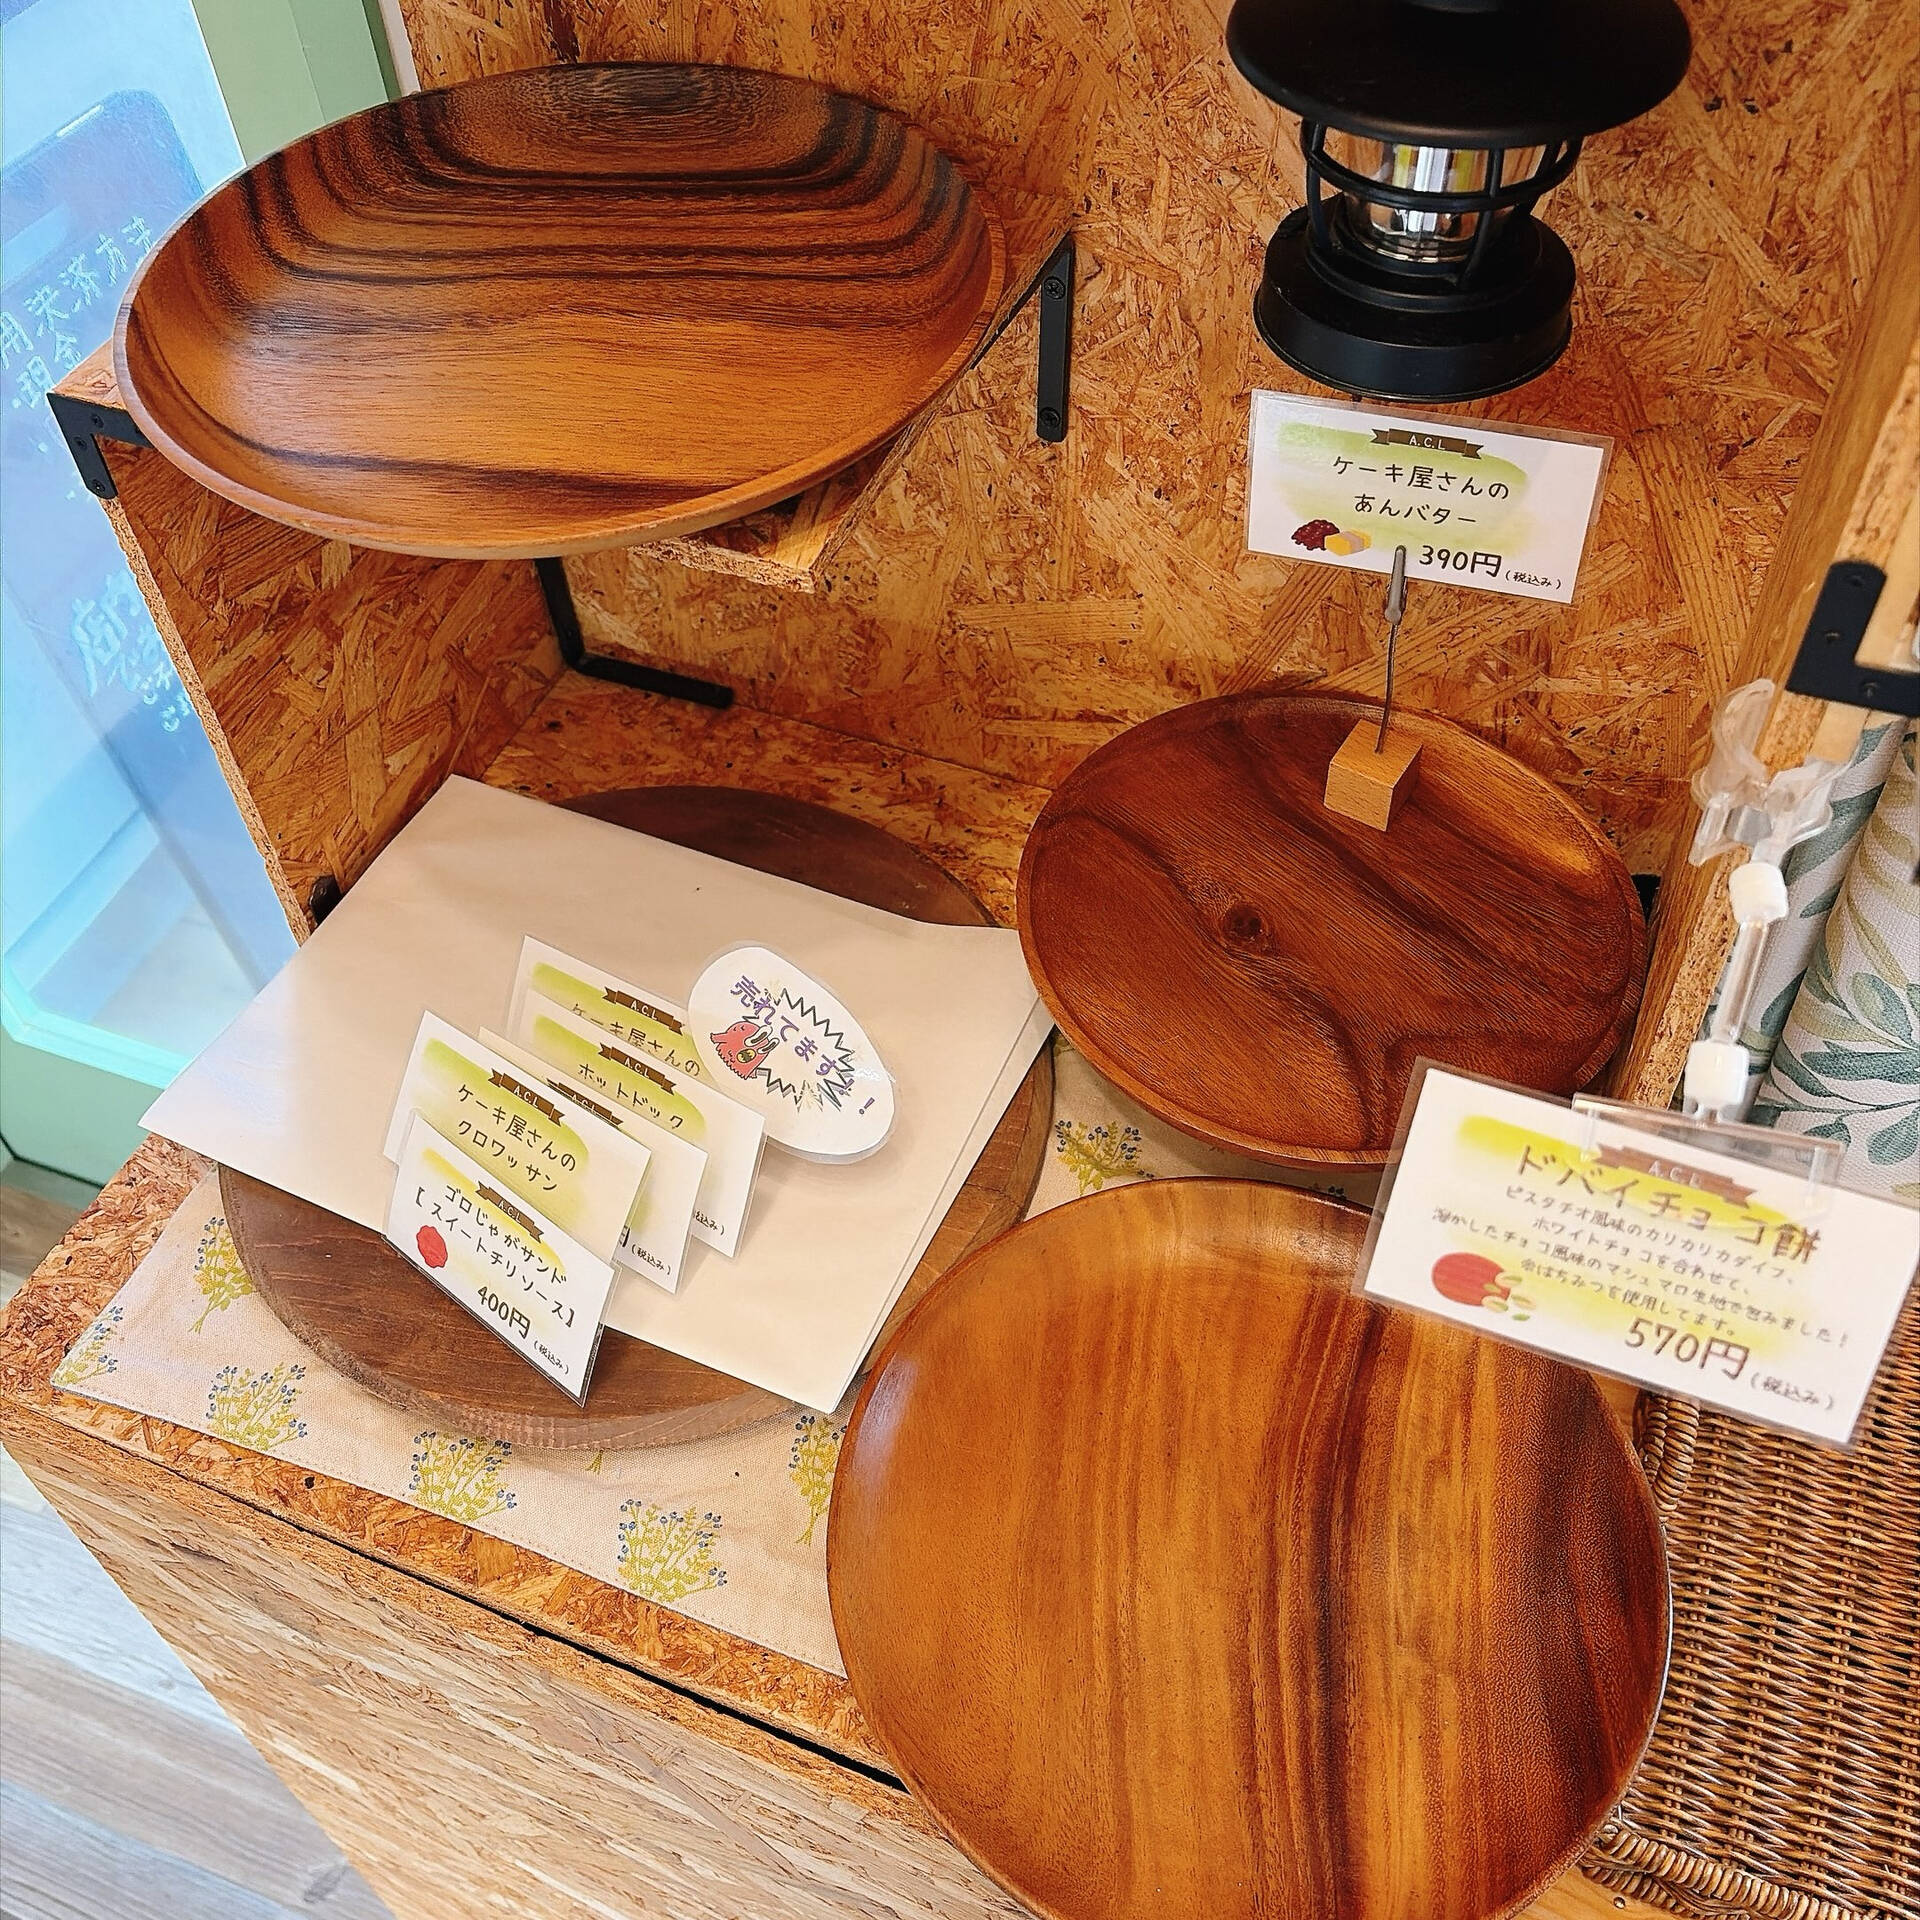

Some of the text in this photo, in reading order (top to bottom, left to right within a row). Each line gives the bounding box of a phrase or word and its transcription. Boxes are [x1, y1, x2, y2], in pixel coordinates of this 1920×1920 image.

[1408, 434, 1446, 451] A.C.L
[1333, 456, 1509, 500] ケーキ屋さんの
[1354, 493, 1477, 524] あんバター
[1419, 545, 1503, 578] 390円
[630, 1000, 658, 1021] A.C.L
[572, 1003, 701, 1077] ケーキ屋さんの
[624, 1056, 651, 1079] A.C.L
[513, 1085, 539, 1109] A.C.L
[578, 1063, 684, 1129] ホットドック
[458, 1084, 577, 1172] ケーキ屋さんの
[458, 1120, 558, 1191] クロワッサン
[497, 1200, 522, 1224] A.C.L
[1518, 1145, 1821, 1265] ドバイチョコ餅
[444, 1185, 567, 1285] ゴロじゃがサンド
[1532, 1215, 1750, 1296] ホワイトチョコを合わせて、
[477, 1286, 532, 1340] 400円
[1624, 1316, 1751, 1381] 570円
